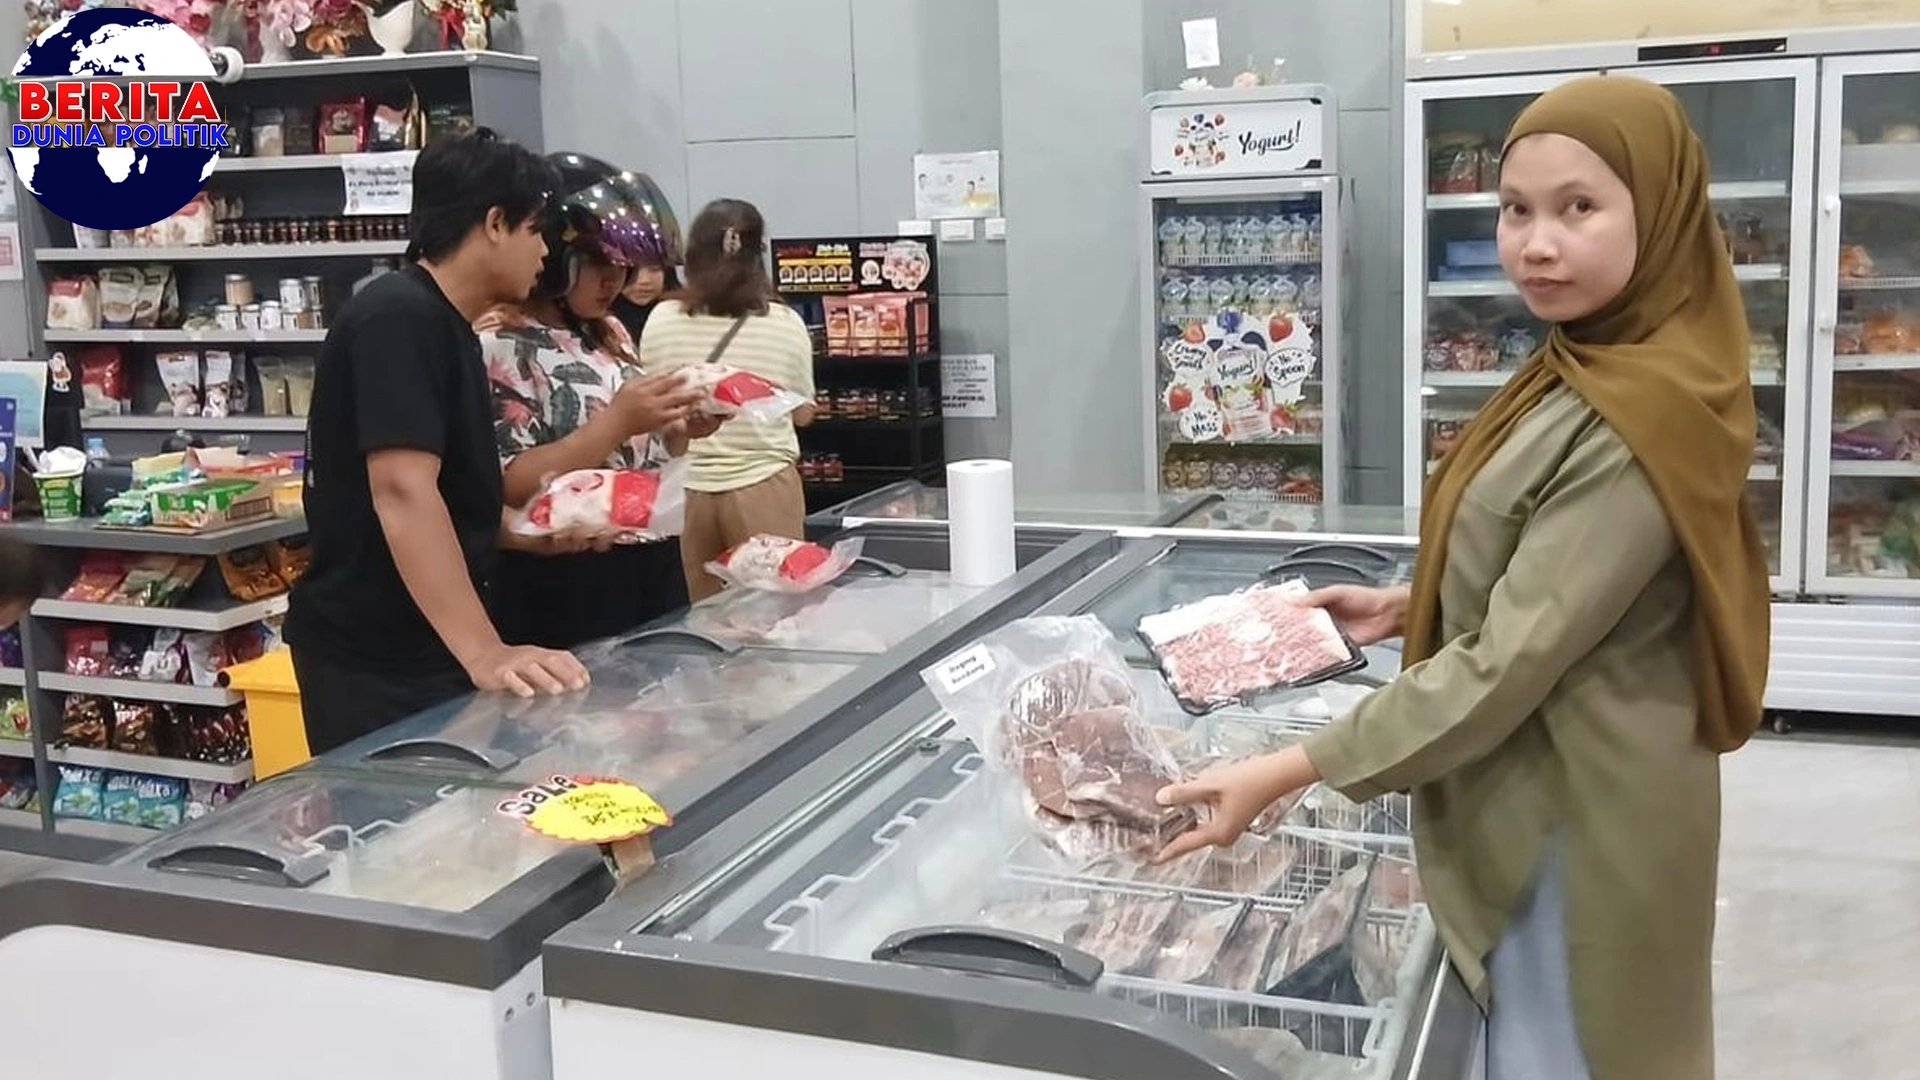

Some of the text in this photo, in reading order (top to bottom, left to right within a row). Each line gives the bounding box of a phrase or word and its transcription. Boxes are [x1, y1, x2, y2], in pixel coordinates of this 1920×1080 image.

[1238, 119, 1302, 156] Yogurt!
[1273, 364, 1306, 381] Spoon
[1191, 421, 1218, 438] Mess
